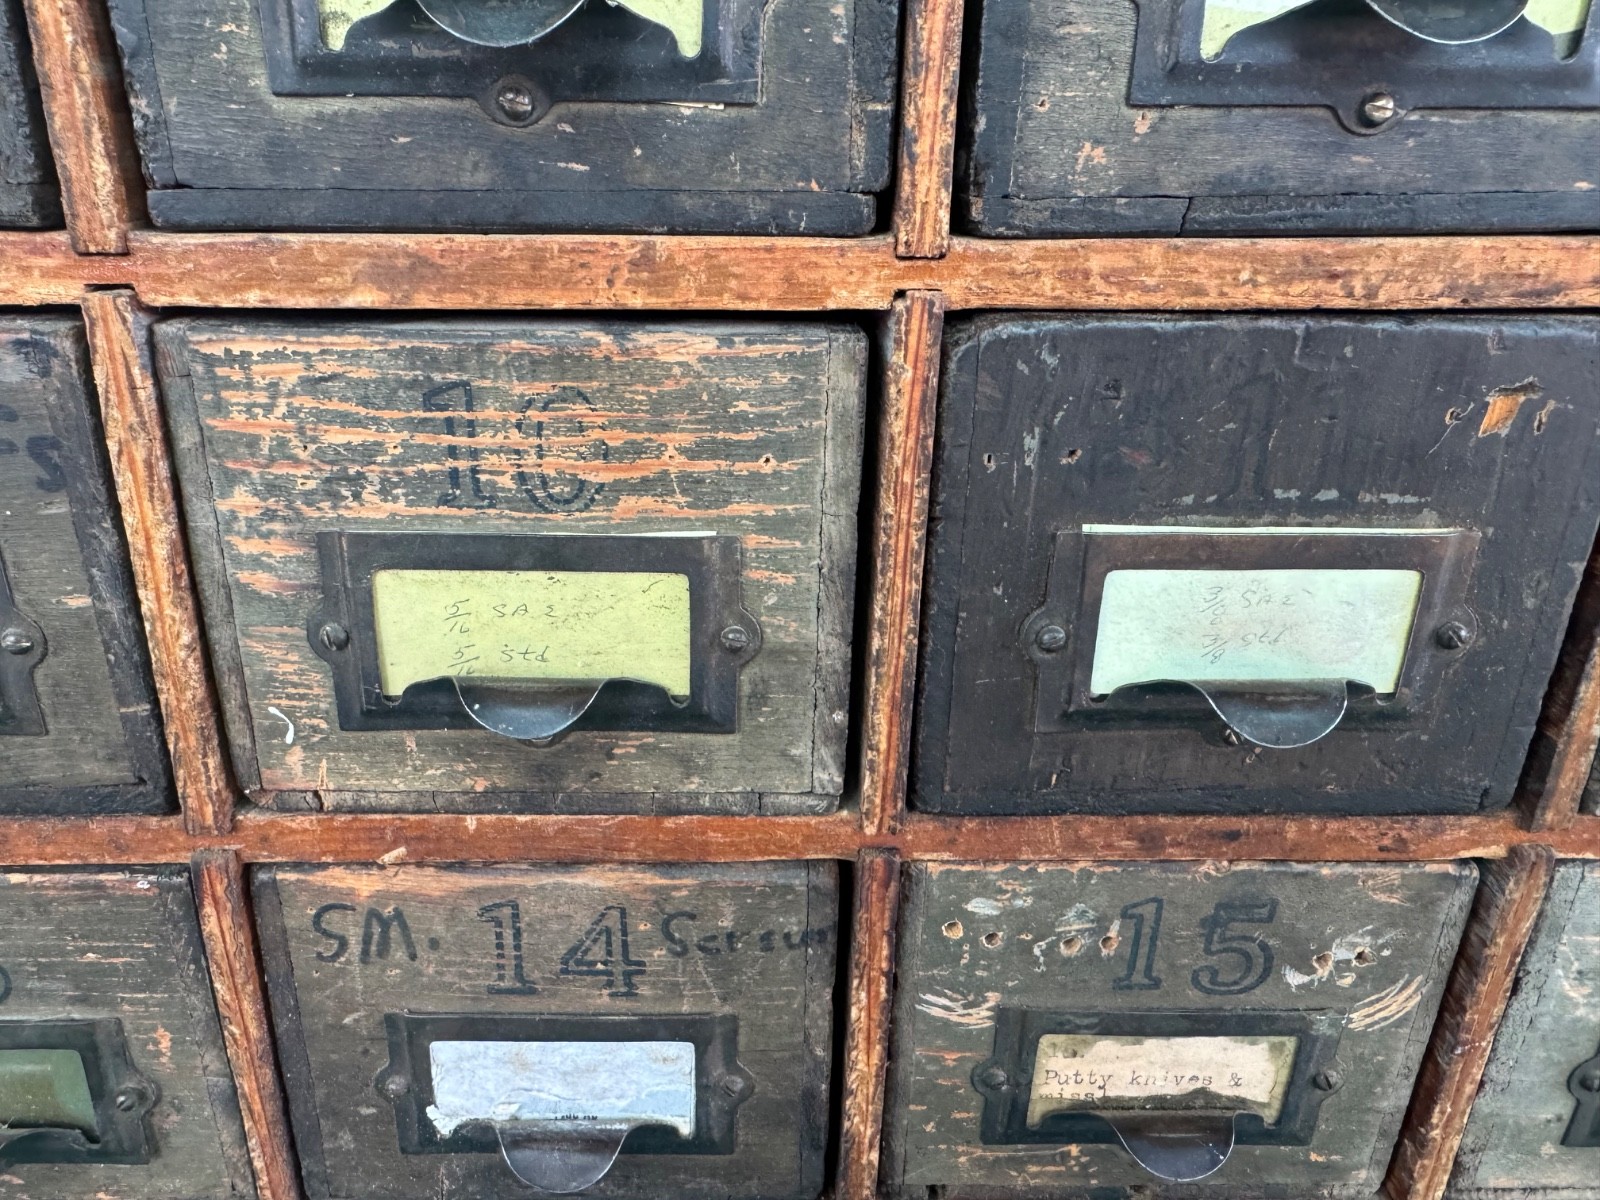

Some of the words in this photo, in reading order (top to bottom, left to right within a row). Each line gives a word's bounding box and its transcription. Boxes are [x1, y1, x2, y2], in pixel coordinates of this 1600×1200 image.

[475, 899, 647, 997] 14
[1112, 897, 1280, 996] 15
[1041, 1069, 1114, 1090] Putty
[1128, 1069, 1214, 1088] knives
[1228, 1071, 1244, 1088] &
